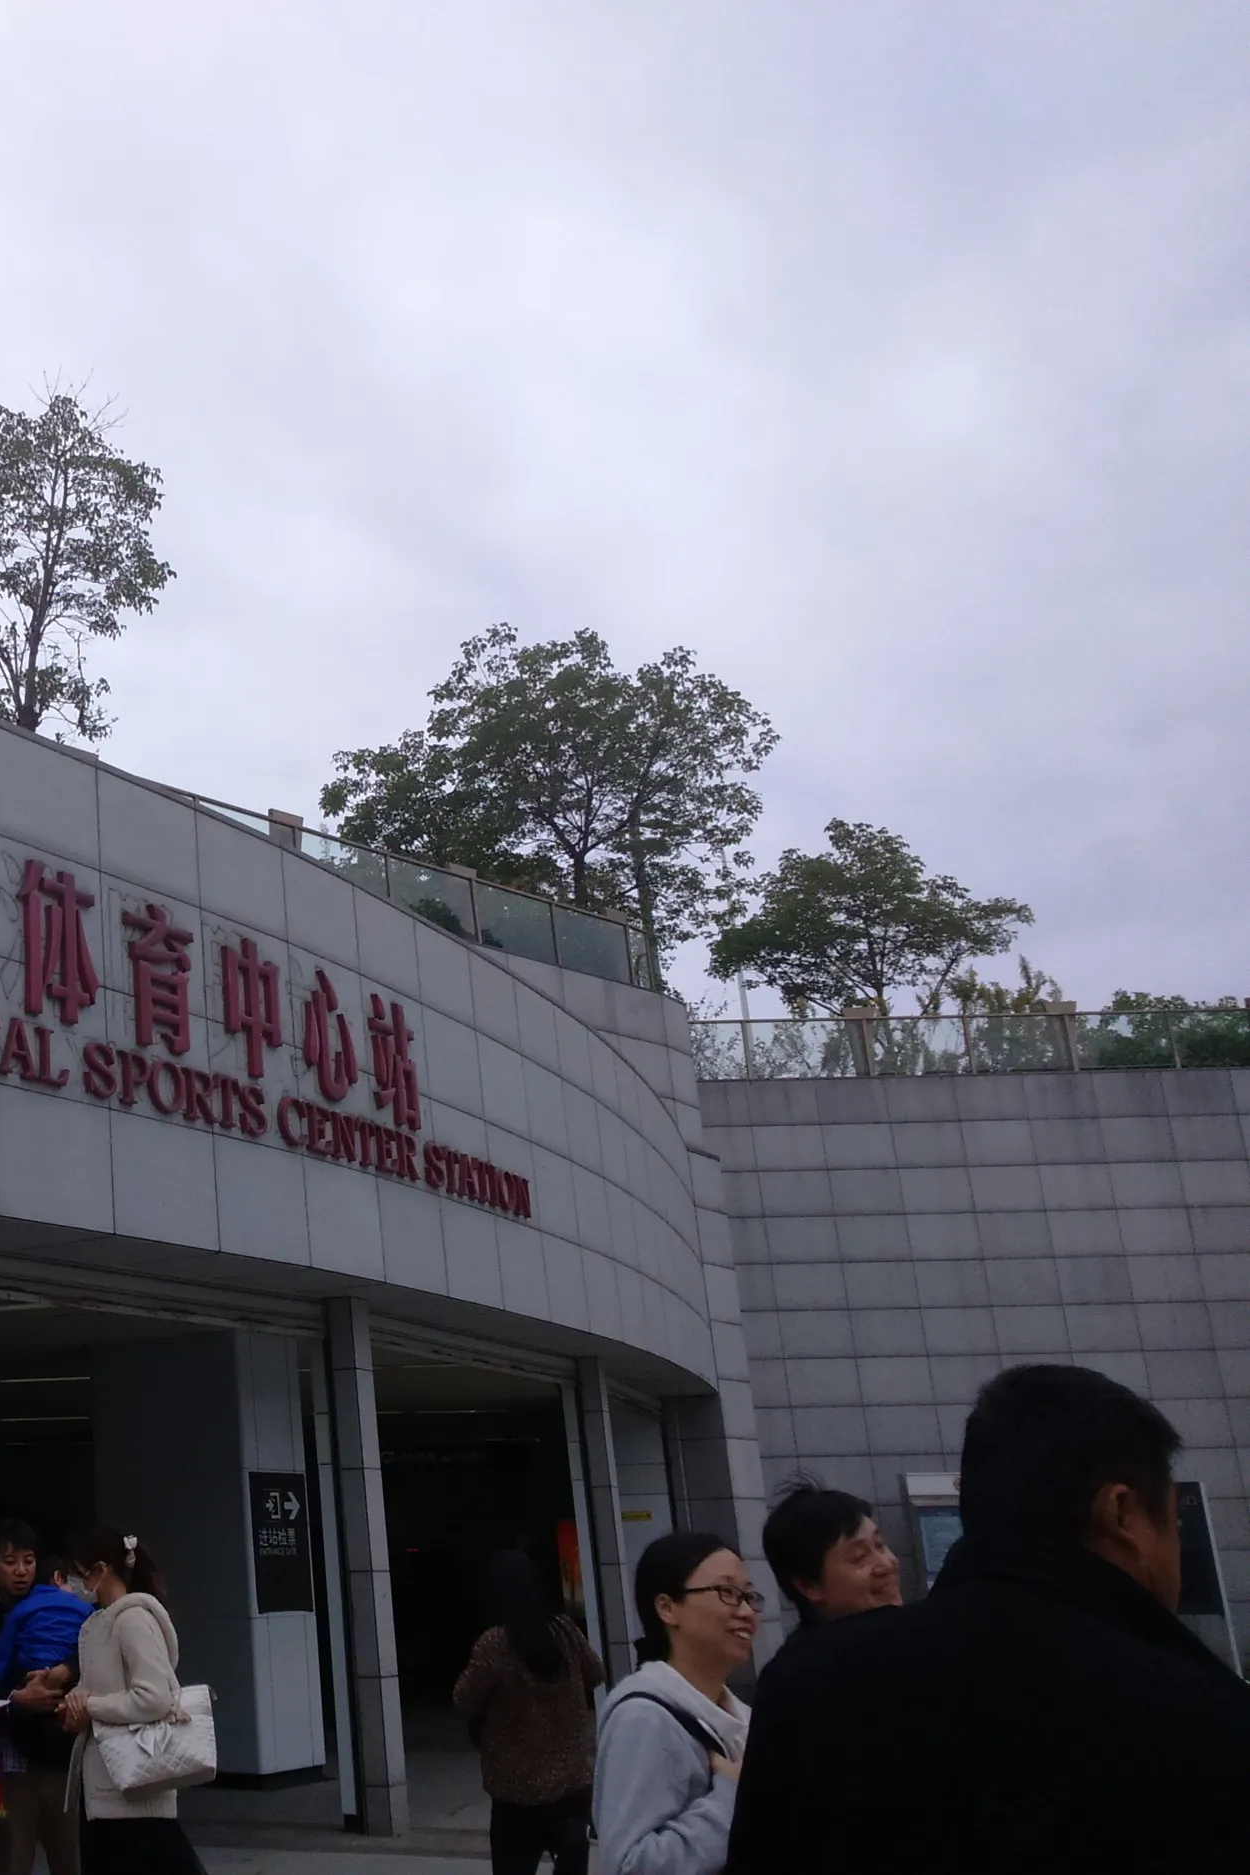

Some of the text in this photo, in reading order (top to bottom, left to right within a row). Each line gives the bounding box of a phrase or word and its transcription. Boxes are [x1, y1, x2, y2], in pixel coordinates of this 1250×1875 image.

[83, 1041, 269, 1138] SPORTS
[276, 1096, 420, 1181] CENTER
[423, 1140, 532, 1219] STATION
